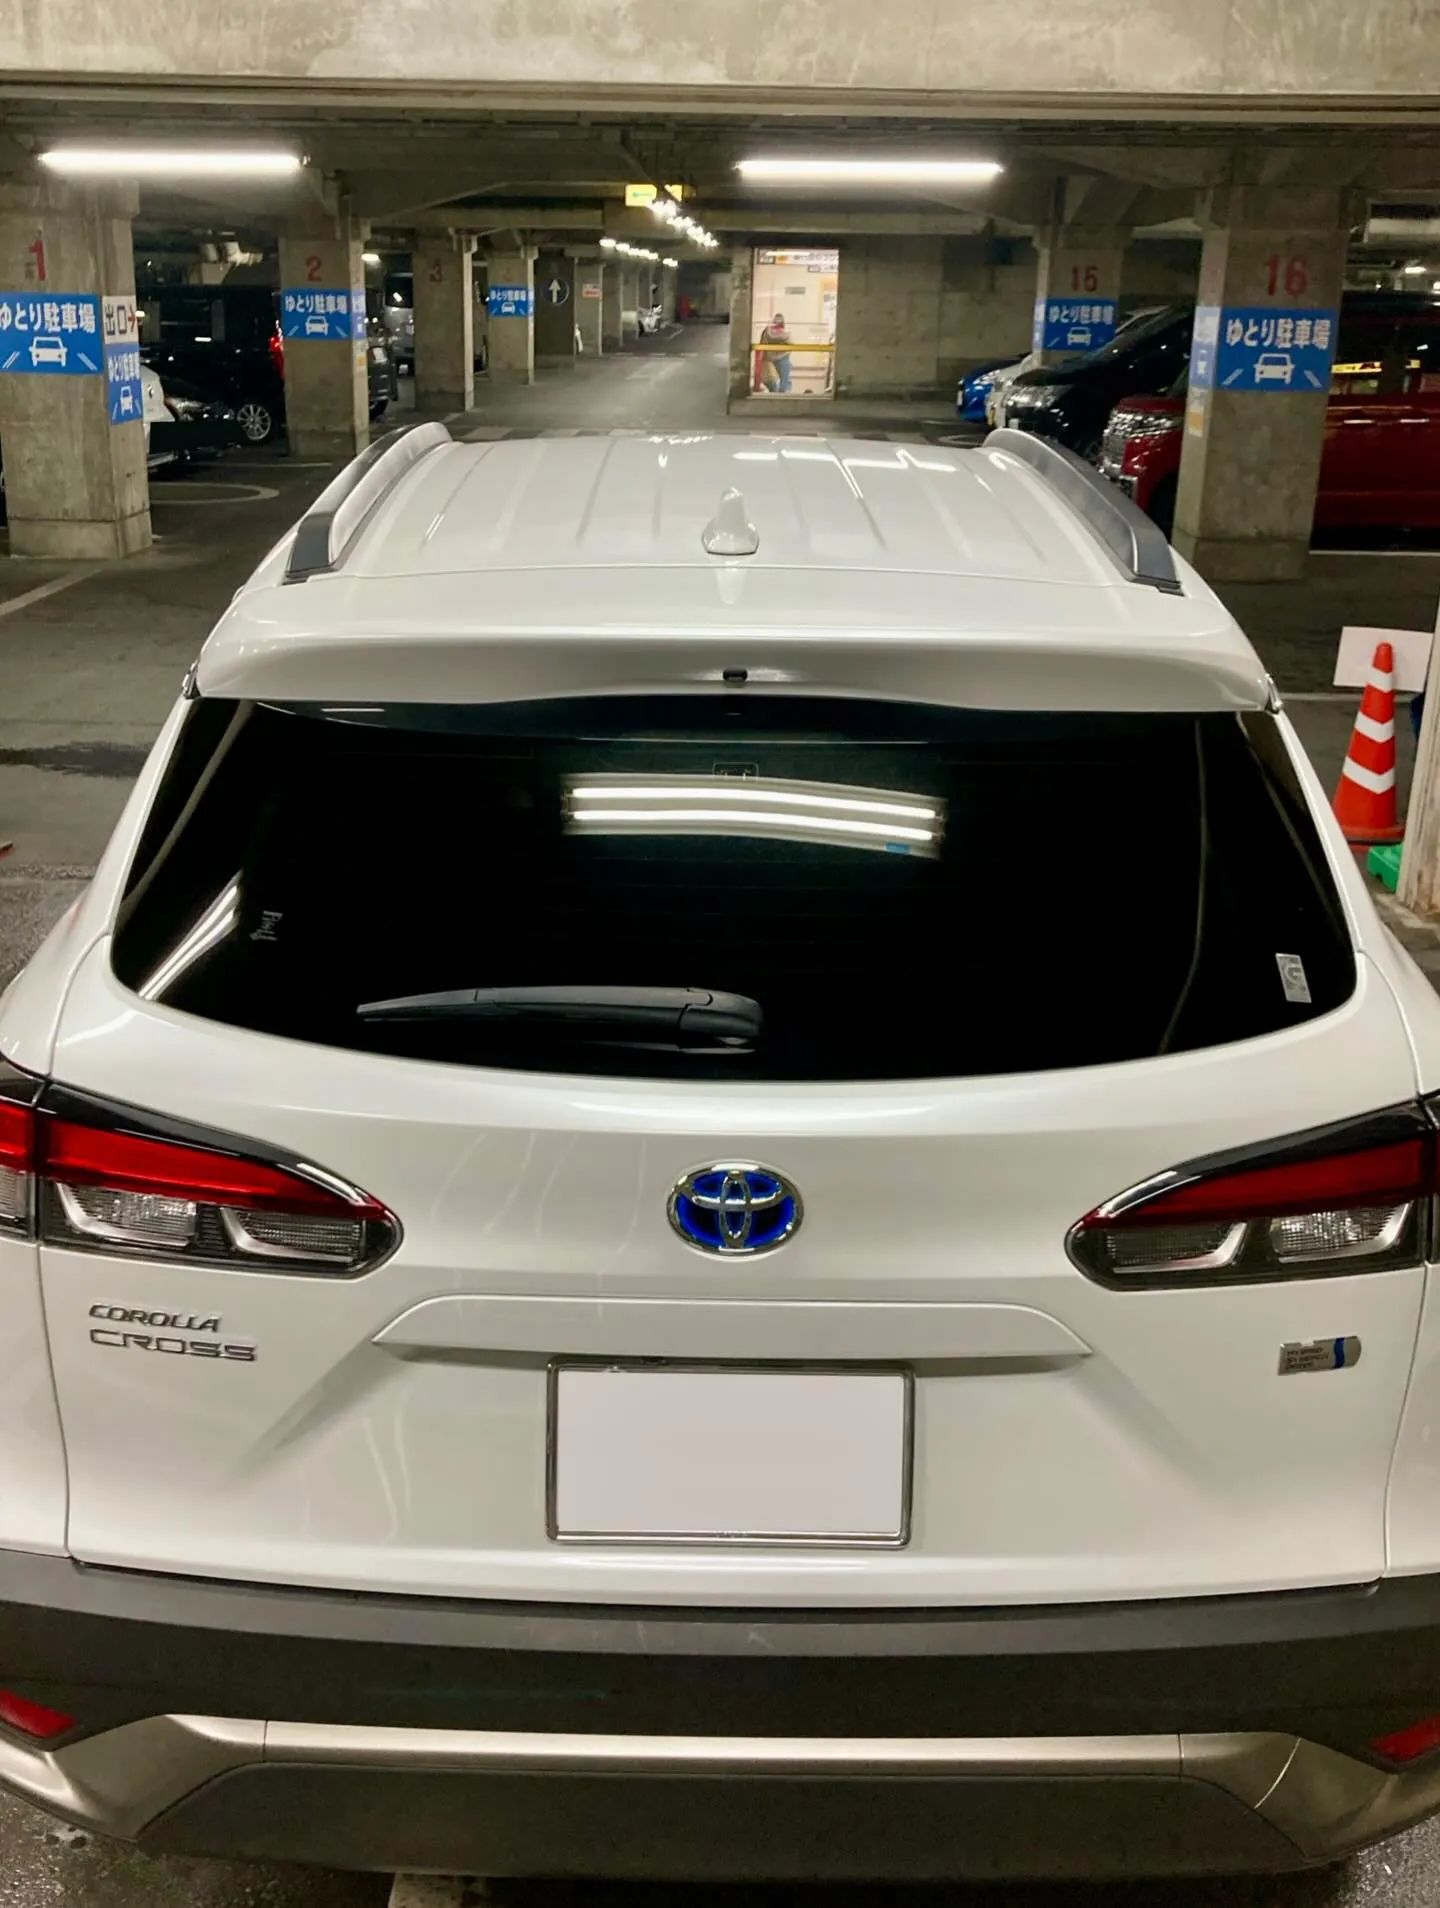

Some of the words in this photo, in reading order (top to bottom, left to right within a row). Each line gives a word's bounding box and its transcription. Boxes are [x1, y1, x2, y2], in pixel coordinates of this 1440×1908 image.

[28, 239, 46, 281] 1
[306, 256, 323, 282] 2
[1266, 254, 1308, 296] 16
[1072, 265, 1099, 292] 15
[0, 302, 95, 334] ゆとり駐車場
[105, 304, 128, 336] 出口
[1226, 318, 1331, 349] ゆとり駐車場
[88, 1302, 221, 1332] COROLLA
[90, 1328, 257, 1362] CROSS
